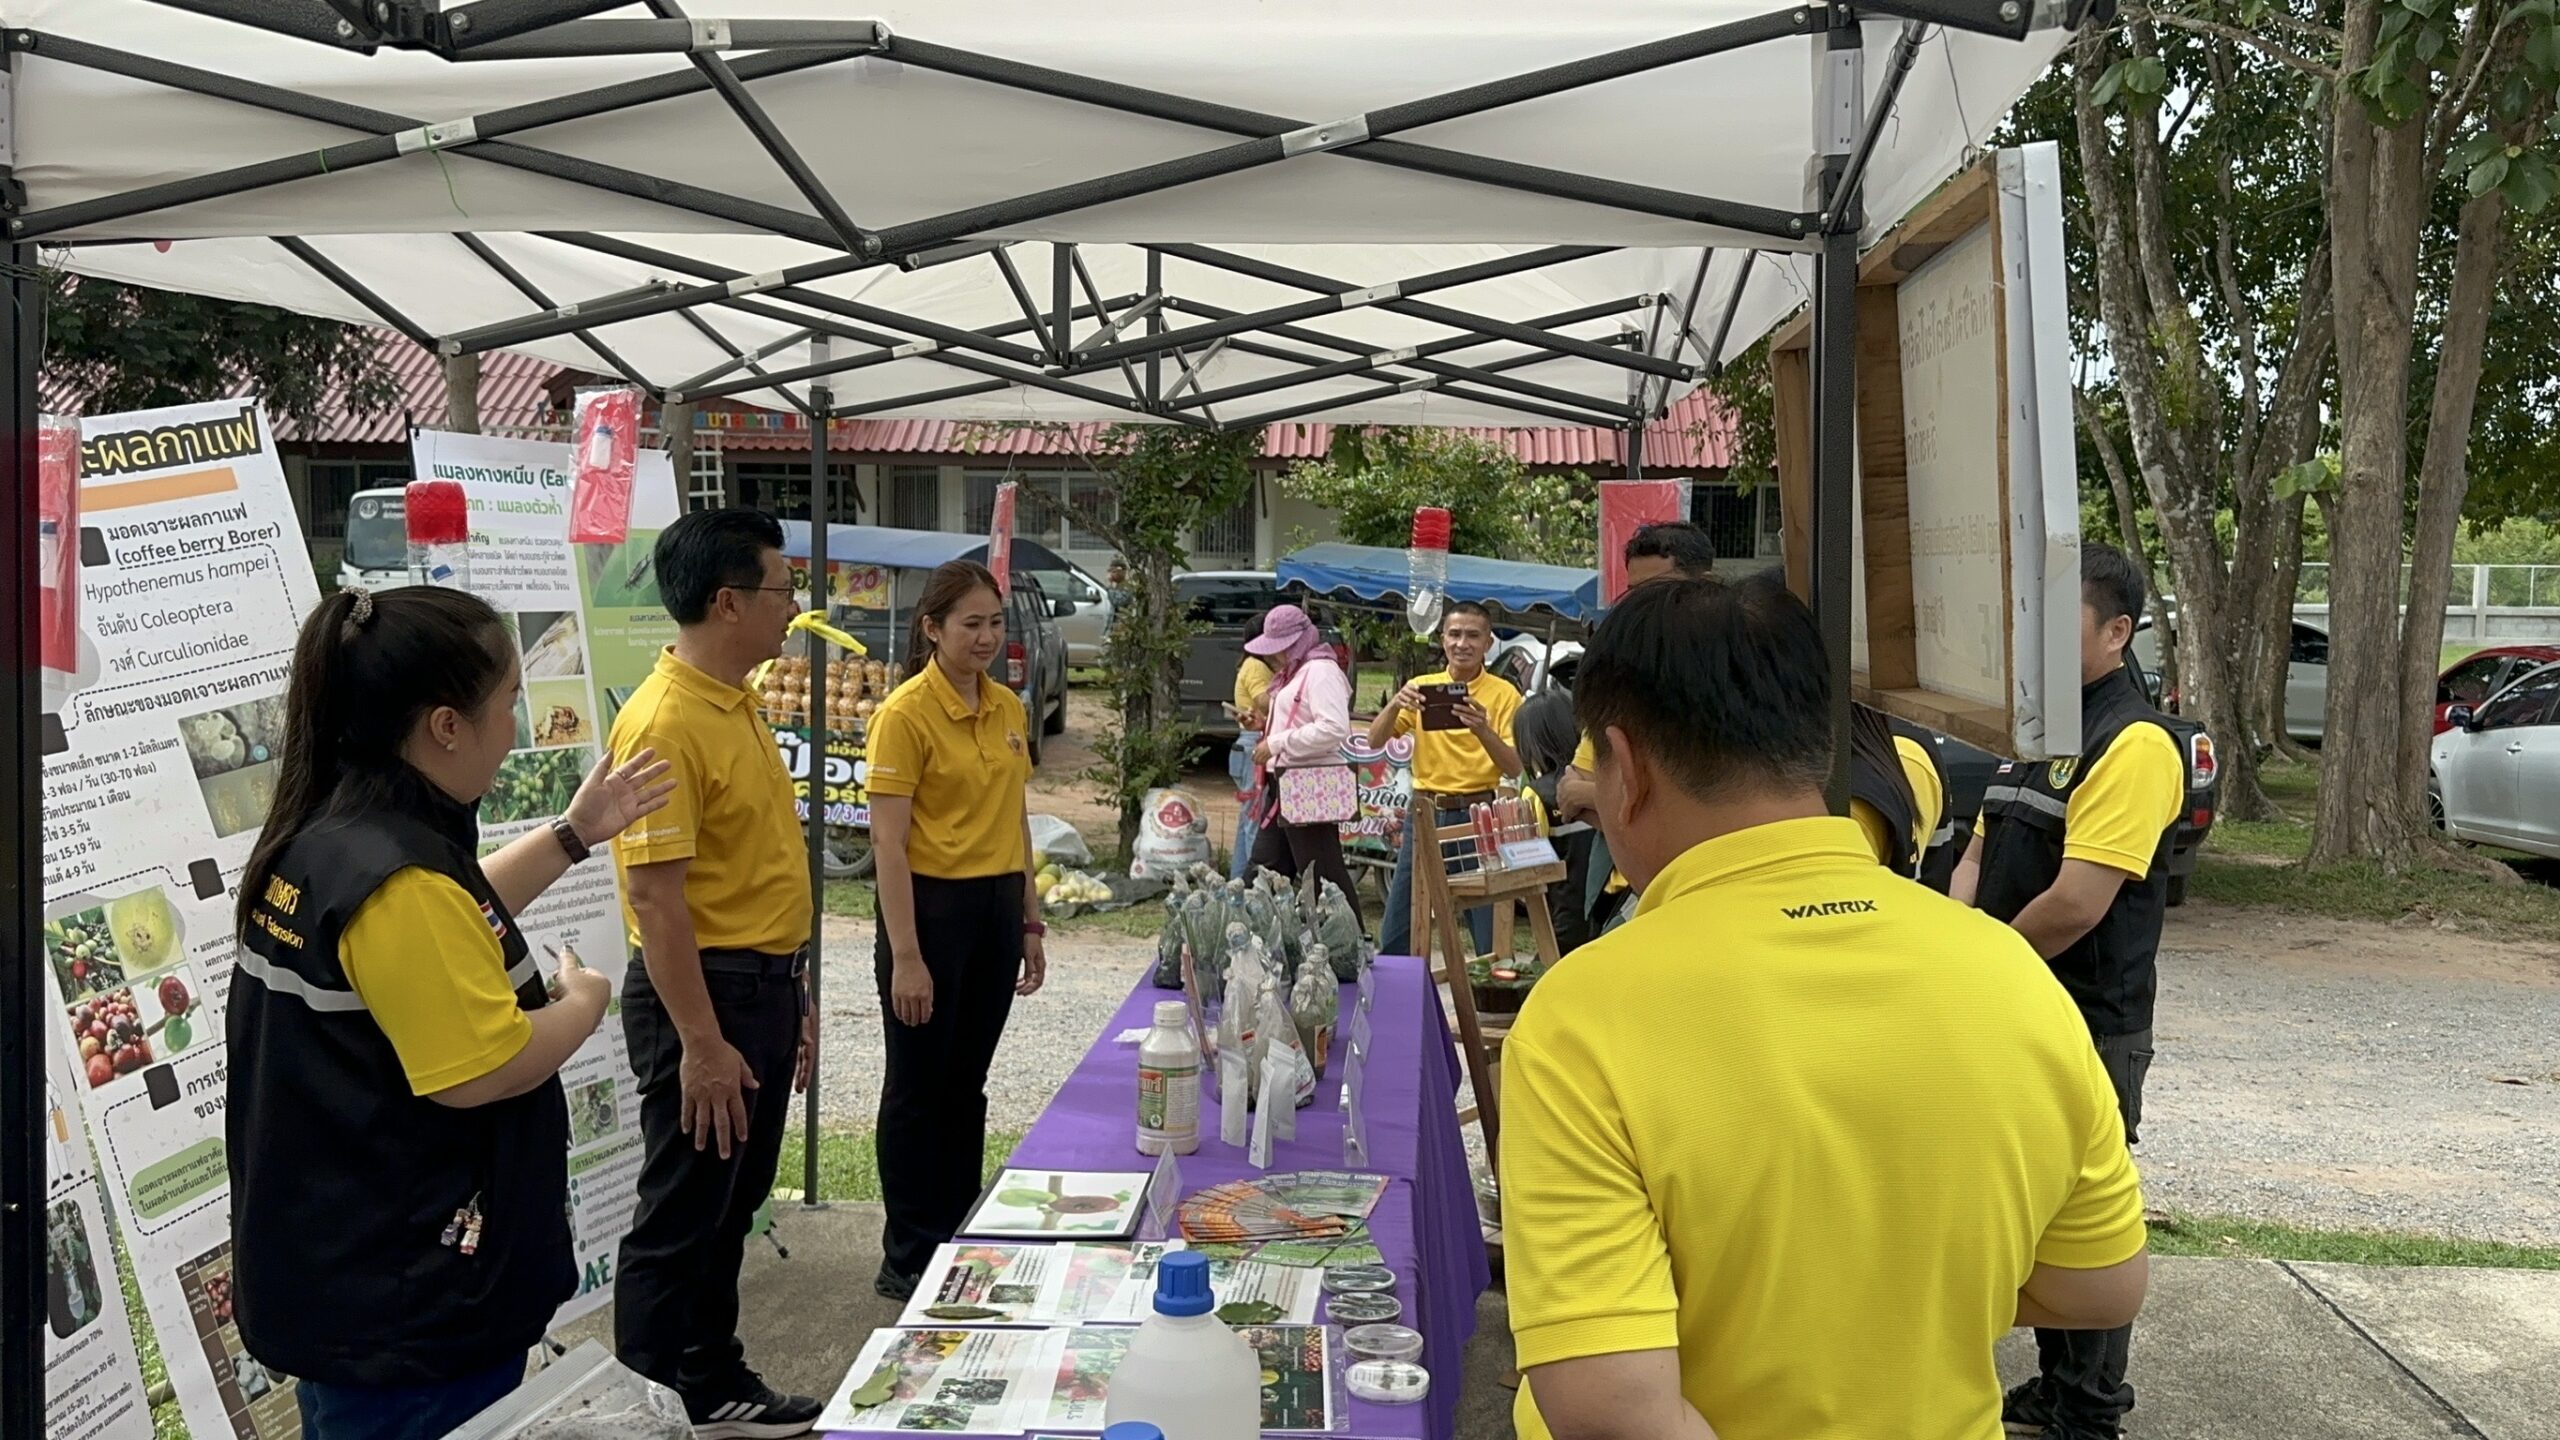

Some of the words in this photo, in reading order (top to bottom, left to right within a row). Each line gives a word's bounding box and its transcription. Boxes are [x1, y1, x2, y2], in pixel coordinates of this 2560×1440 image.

[81, 411, 258, 474] ะผลกาแฟ
[433, 463, 534, 486] แมลงหางหนีบ
[497, 493, 562, 515] แมลงตัวห้ำ
[107, 502, 248, 542] มอดเจาะผลกาแฟ
[115, 544, 177, 566] (coffee
[181, 533, 225, 555] berry
[229, 521, 281, 546] Borer)
[85, 569, 205, 603] Hypothenemus
[208, 553, 270, 583] hampei
[849, 568, 881, 594] 20
[141, 600, 233, 632] Coleoptera
[110, 651, 136, 673] วงศ์
[137, 631, 250, 669] Curculionidae
[95, 751, 121, 766] ขนาด
[122, 746, 139, 759] 1-2
[139, 737, 180, 756] มิลลิเมตร
[58, 782, 77, 796] ฟอง
[86, 774, 100, 788] วัน
[101, 767, 132, 786] (30-70
[133, 761, 157, 778] ฟอง)
[99, 795, 105, 807] 1
[107, 788, 131, 805] เดือน
[60, 823, 76, 839] 3-5
[77, 818, 90, 833] วัน
[59, 842, 86, 861] 15-19
[88, 836, 101, 851] วัน
[65, 865, 80, 880] 4-9
[81, 860, 96, 875] วัน
[1780, 899, 1879, 919] WARRIX
